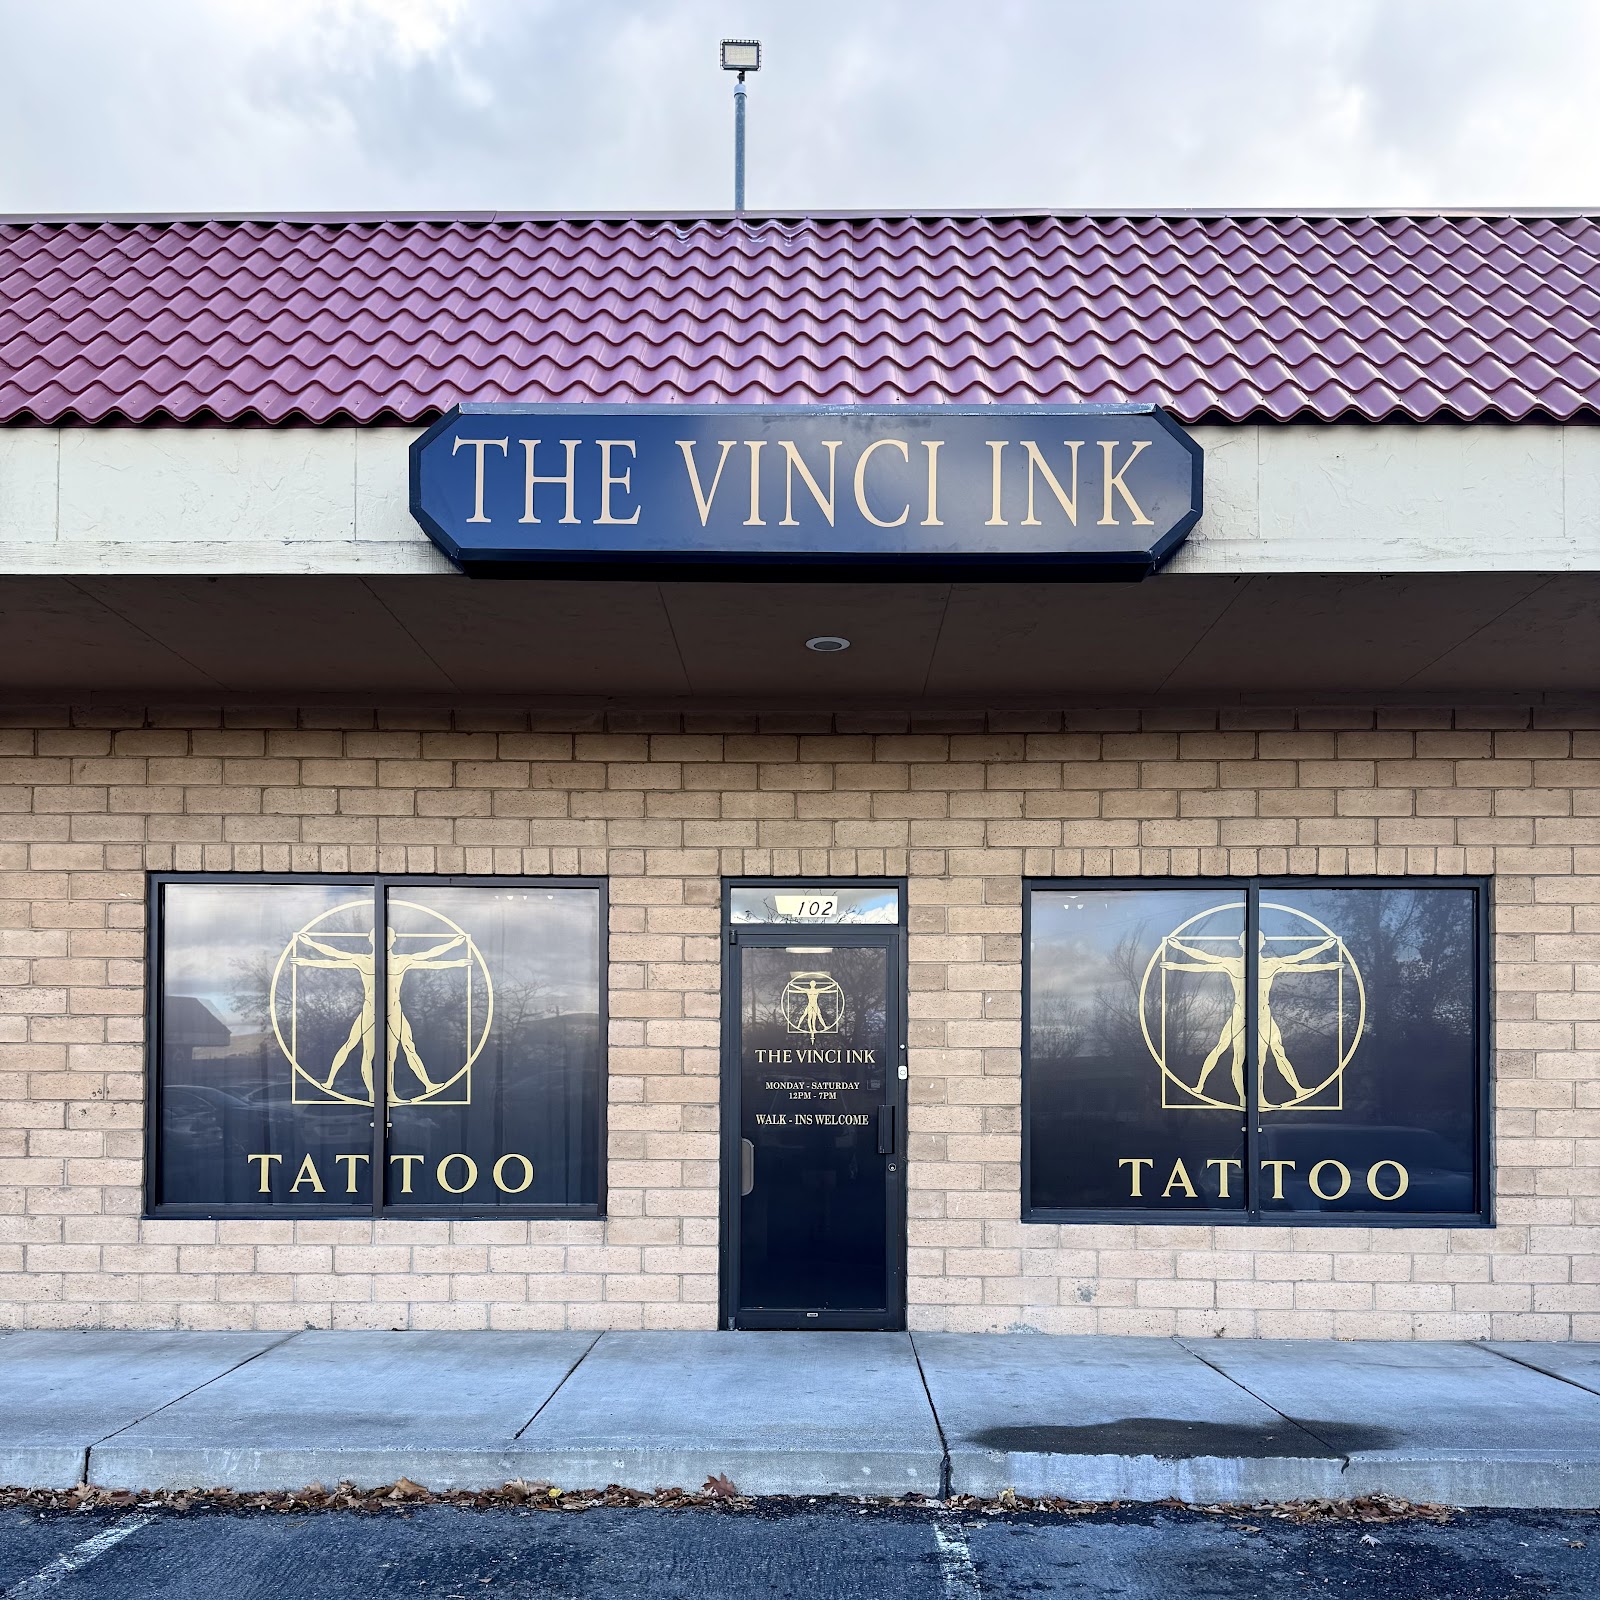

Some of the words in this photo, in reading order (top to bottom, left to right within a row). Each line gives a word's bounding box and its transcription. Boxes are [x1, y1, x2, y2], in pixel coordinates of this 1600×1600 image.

[452, 435, 641, 526] THE
[674, 438, 945, 528] VINCI
[984, 440, 1155, 527] INK
[798, 901, 833, 916] 102
[754, 1049, 793, 1064] THE
[795, 1049, 842, 1064] VINCI
[846, 1049, 876, 1064] INK
[765, 1081, 805, 1090] MONDAY
[811, 1081, 860, 1090] SATURDAY
[789, 1091, 812, 1100] 12PM
[818, 1091, 837, 1100] 7PM
[755, 1114, 787, 1125] WALK
[794, 1114, 813, 1125] INS
[814, 1114, 869, 1126] WELCOME
[247, 1152, 535, 1195] TATTOO
[1118, 1157, 1410, 1202] TATTOO
